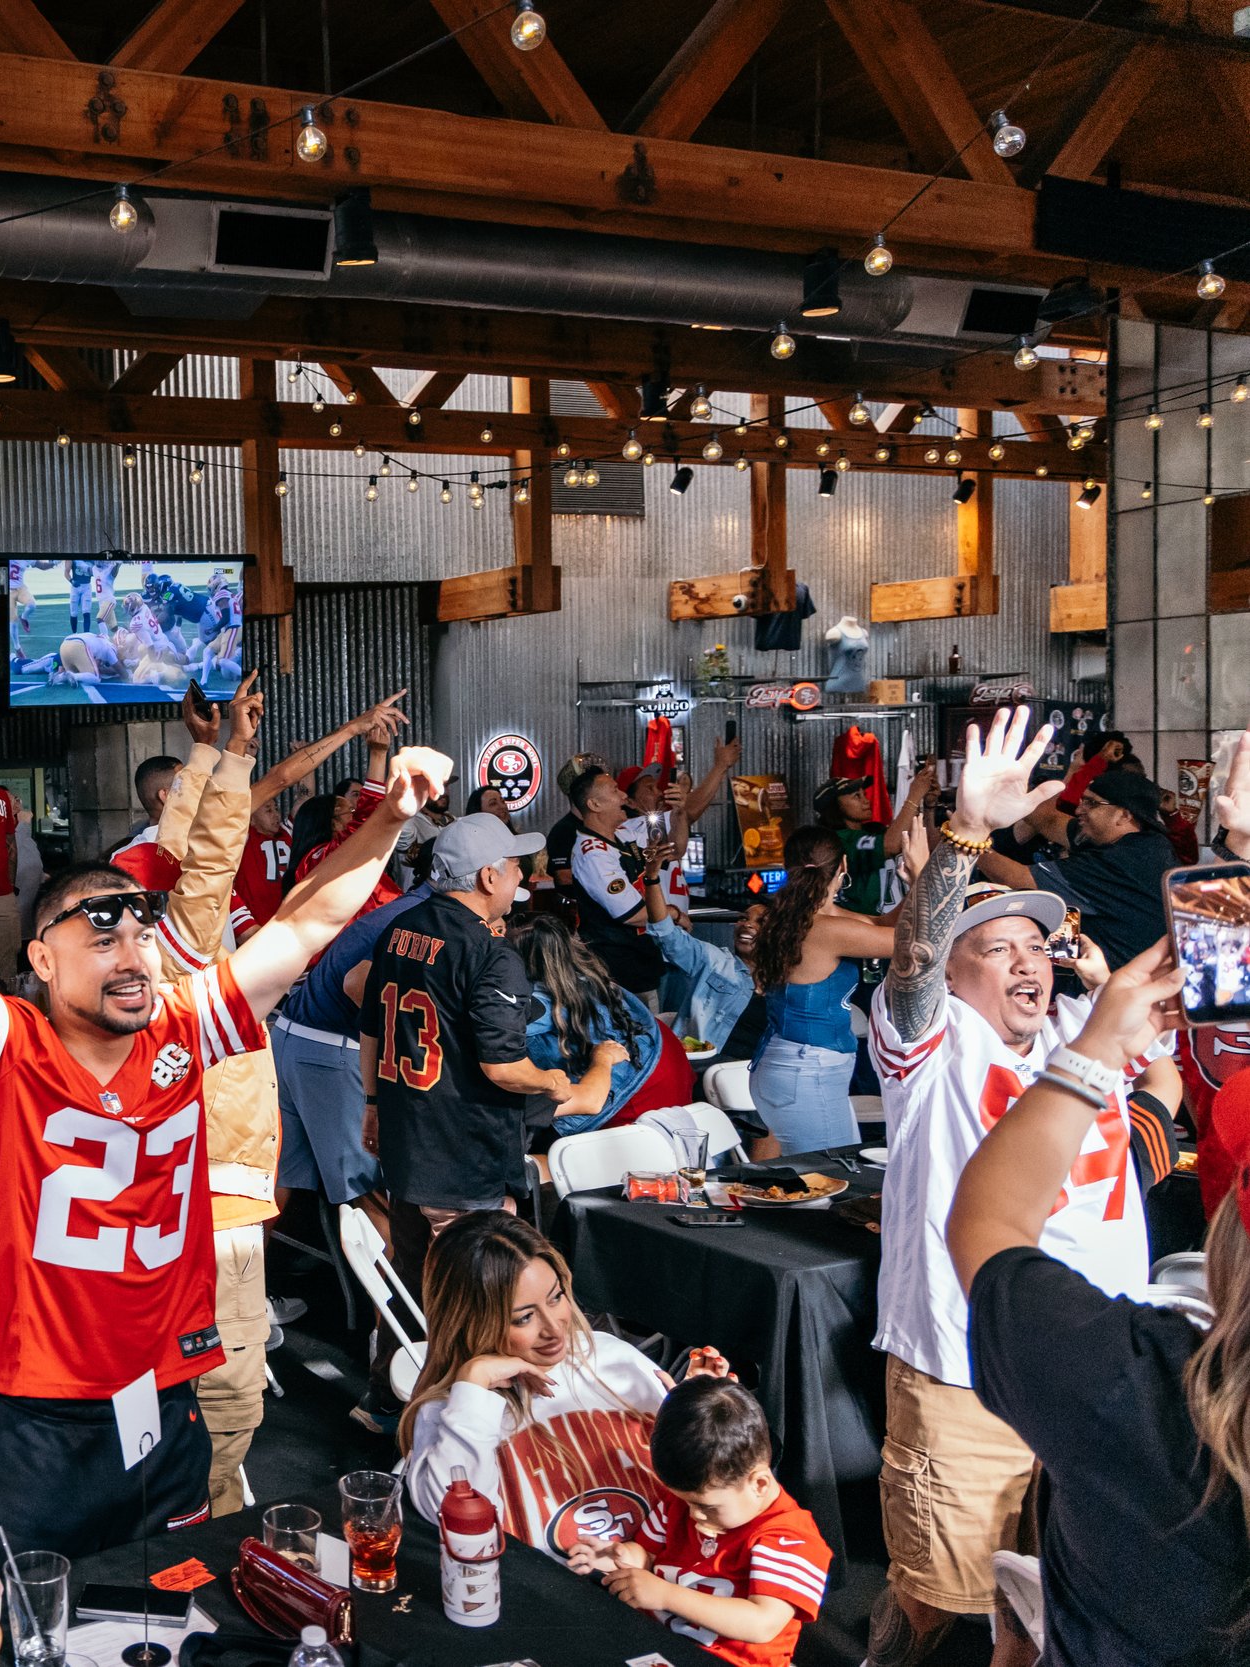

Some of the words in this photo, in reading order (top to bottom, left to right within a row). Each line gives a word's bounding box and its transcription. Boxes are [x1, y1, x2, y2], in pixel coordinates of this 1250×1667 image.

[581, 838, 608, 855] 23
[387, 928, 446, 965] PURDY
[378, 981, 444, 1092] 13
[32, 1099, 200, 1273] 23
[573, 1499, 633, 1542] SF
